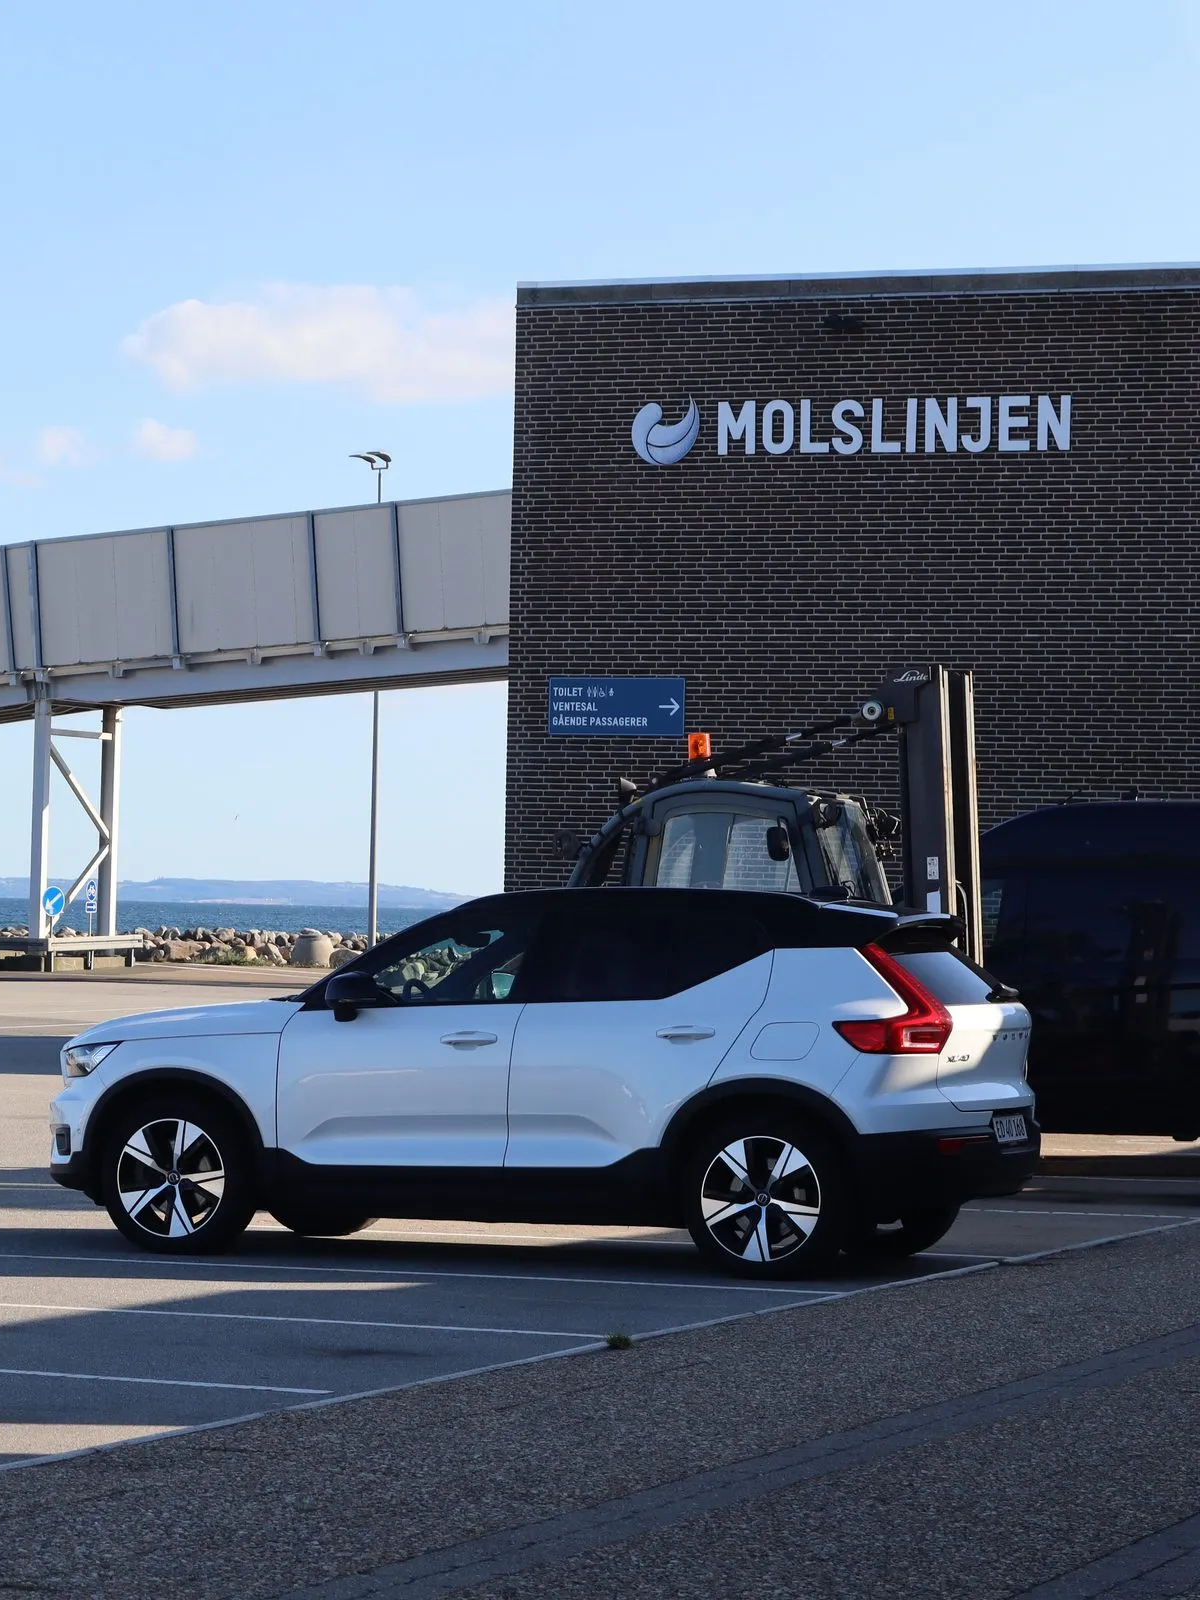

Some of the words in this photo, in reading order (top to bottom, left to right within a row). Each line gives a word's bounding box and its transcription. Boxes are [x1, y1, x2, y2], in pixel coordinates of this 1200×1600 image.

[717, 394, 1072, 455] MOLSLINJEN
[893, 669, 929, 683] Linde
[553, 687, 583, 697] TOILET
[552, 702, 598, 712] VENTESAL
[552, 714, 588, 726] GÅENDE
[589, 717, 648, 727] PASSAGERER
[995, 1120, 1006, 1139] ED
